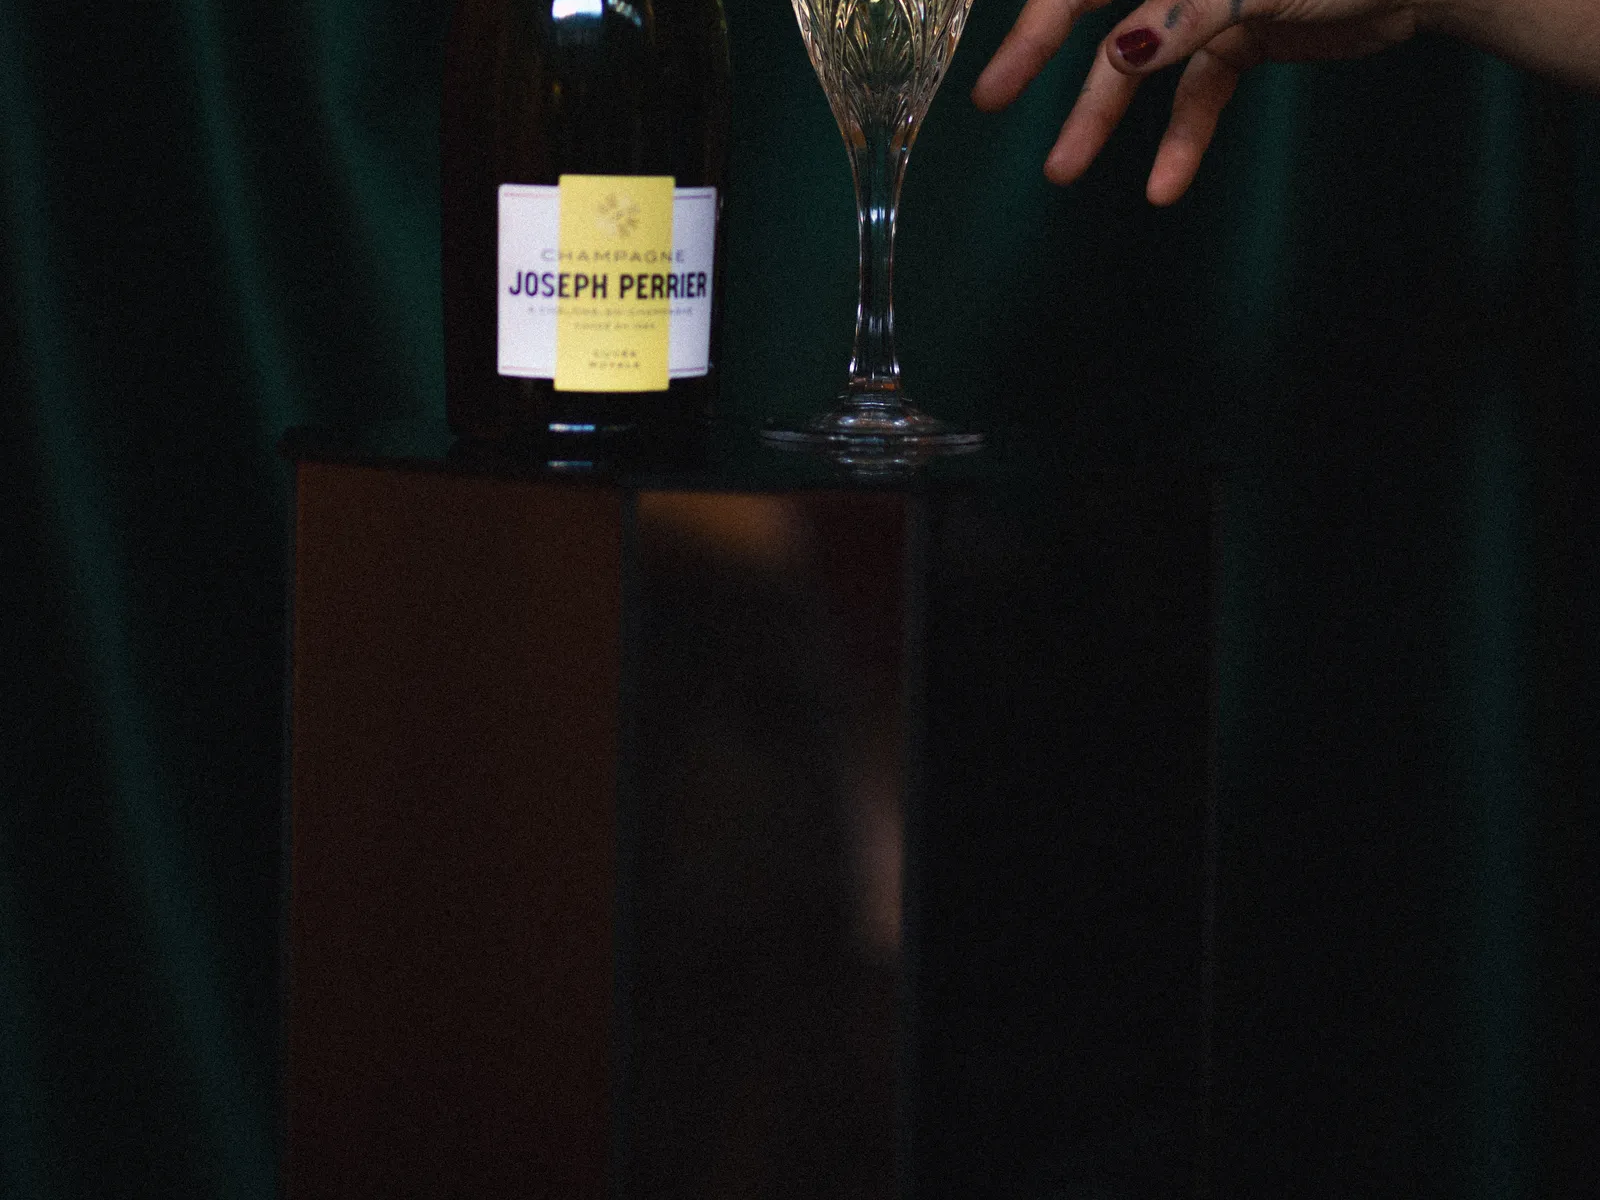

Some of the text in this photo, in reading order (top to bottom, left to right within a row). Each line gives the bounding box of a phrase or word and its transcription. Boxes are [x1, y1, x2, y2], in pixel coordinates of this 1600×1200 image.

[541, 248, 684, 263] CHAMPAGNE
[509, 271, 707, 300] JOSEPH PERRIER
